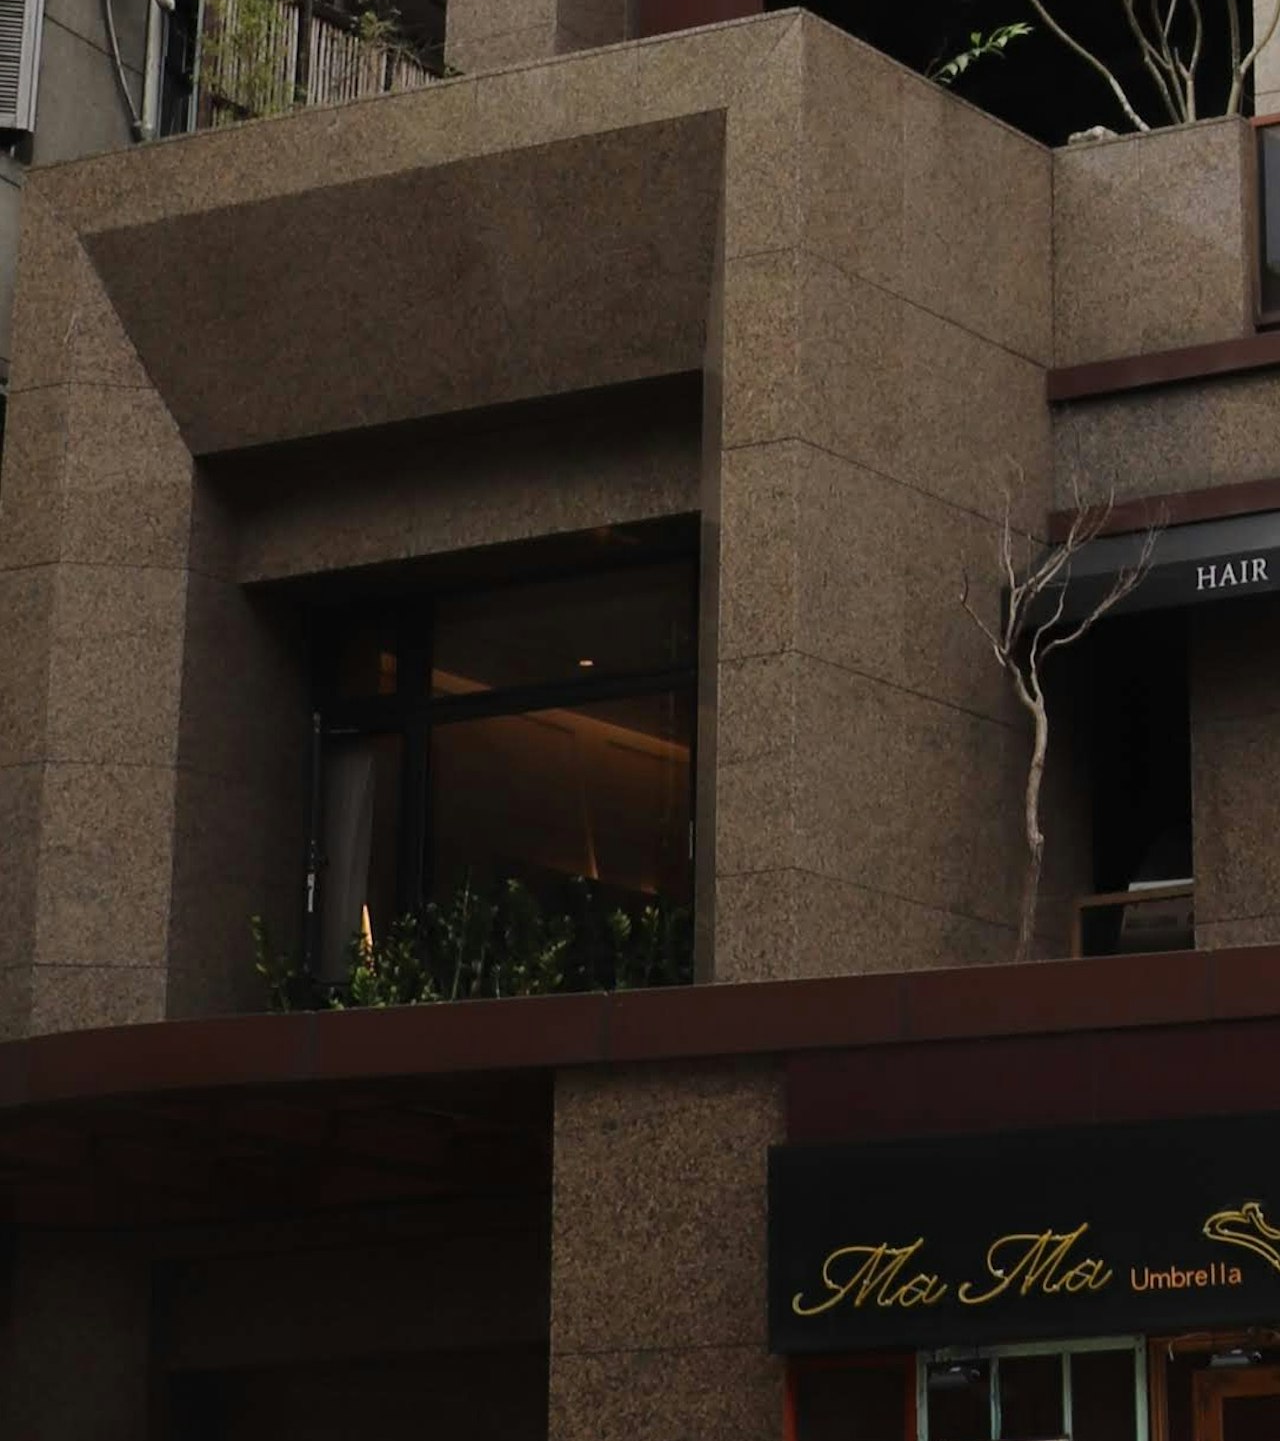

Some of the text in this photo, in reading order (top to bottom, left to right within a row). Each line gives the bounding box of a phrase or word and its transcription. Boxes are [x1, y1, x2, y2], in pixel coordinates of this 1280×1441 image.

[1196, 557, 1268, 591] HAIR
[792, 1237, 948, 1315] Ma
[958, 1221, 1114, 1304] Ma
[1129, 1261, 1242, 1291] Umbrella
